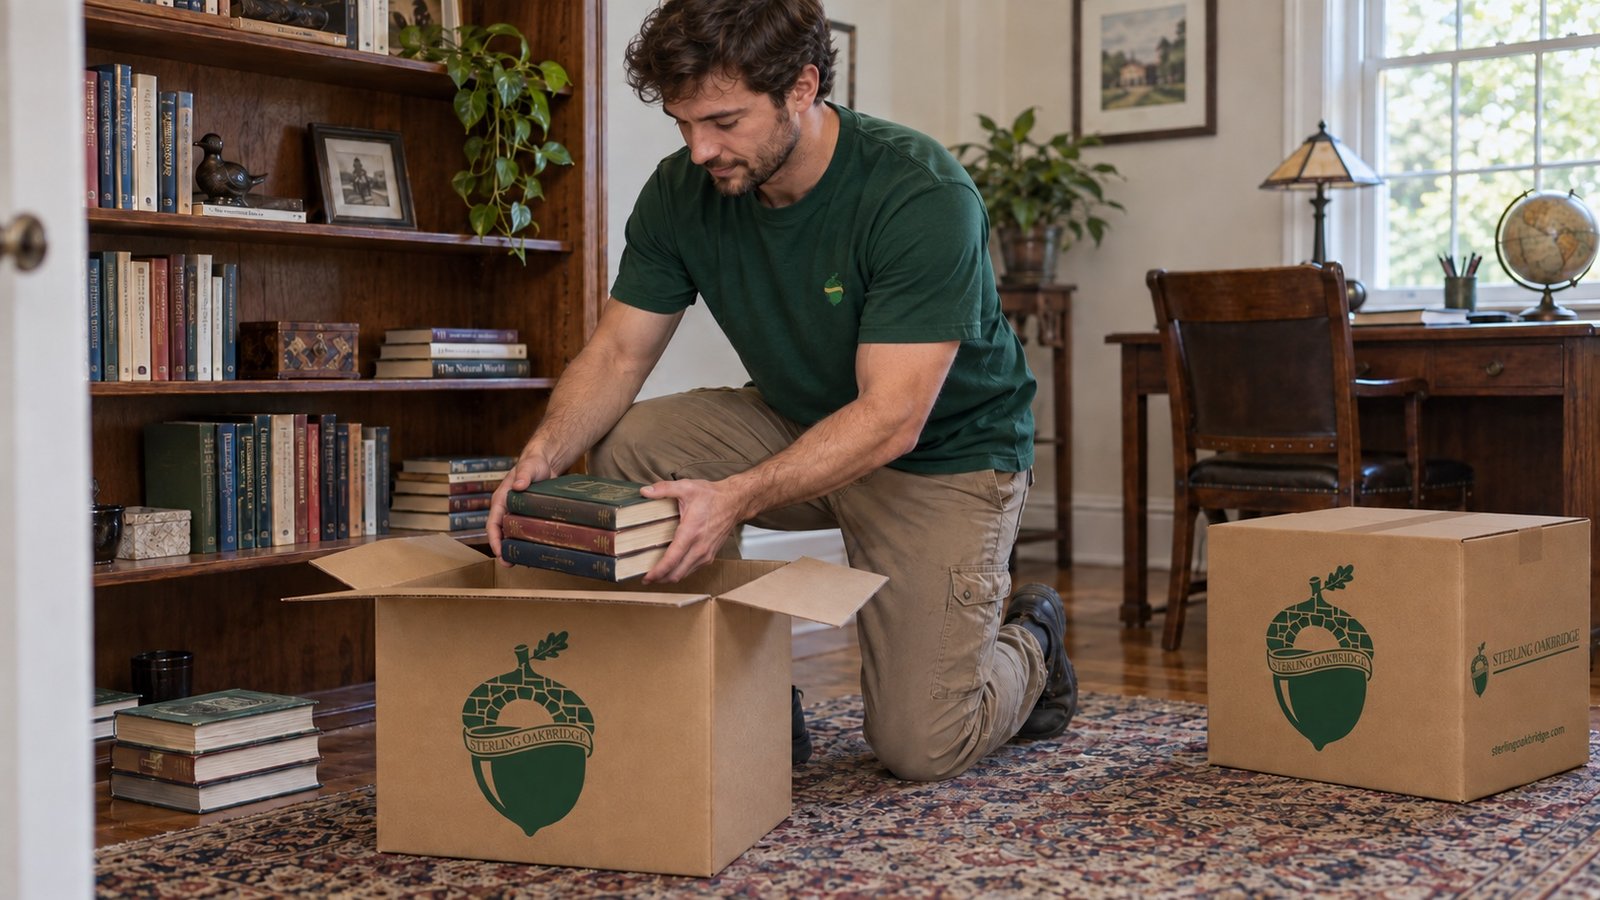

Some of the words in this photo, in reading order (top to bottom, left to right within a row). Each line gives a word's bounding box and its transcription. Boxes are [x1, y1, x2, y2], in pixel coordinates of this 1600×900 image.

[456, 363, 482, 373] Natural
[483, 363, 505, 373] World
[1493, 642, 1533, 667] STERLING
[1534, 628, 1580, 654] OAKBRIDGE
[1272, 657, 1312, 672] STERLING
[470, 735, 521, 752] STERLING
[522, 728, 586, 744] OAKBRIDGE
[1491, 726, 1565, 756] sterlingoakbridge.com
